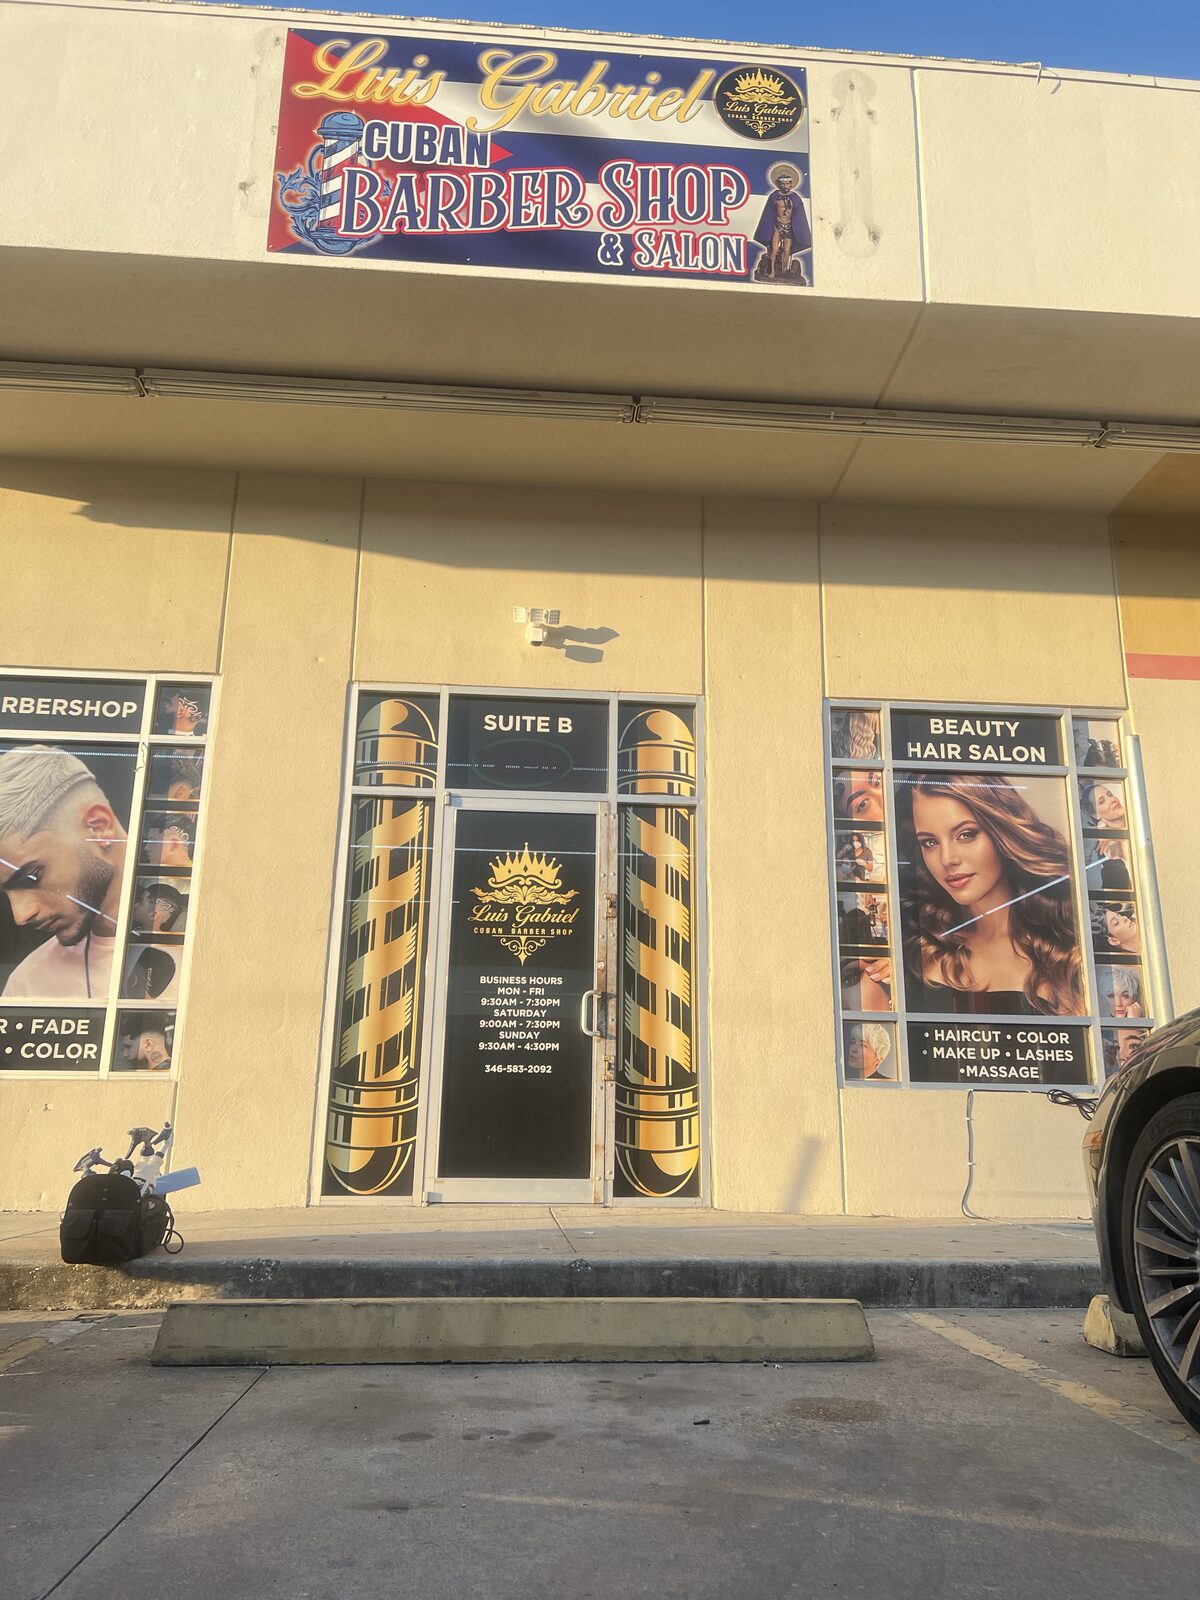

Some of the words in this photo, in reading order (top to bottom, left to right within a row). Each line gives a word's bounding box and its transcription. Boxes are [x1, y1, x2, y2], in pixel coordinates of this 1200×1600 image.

[293, 39, 445, 104] Luis
[465, 50, 714, 133] Gabriel
[723, 101, 750, 112] Luis
[751, 103, 797, 116] Gabriel
[362, 120, 491, 168] CUBAN
[338, 166, 591, 236] BARBER
[599, 160, 749, 229] SHOP
[598, 233, 623, 265] &
[633, 230, 748, 274] SALON
[483, 714, 551, 732] SUITE
[558, 717, 573, 733] B
[929, 718, 1020, 737] BEAUTY
[906, 742, 962, 760] HAIR
[968, 744, 1047, 763] SALON
[467, 904, 508, 922] Luis
[511, 905, 580, 928] Gabriel
[550, 928, 573, 936] SHOP
[480, 976, 527, 985] BUSINESS
[529, 976, 563, 985] HOURS
[497, 987, 520, 995] MON
[529, 987, 545, 996] FRI
[480, 998, 517, 1006] 9:30AM
[526, 998, 560, 1007] 7:30PM
[493, 1009, 547, 1017] SATURDAY
[30, 1018, 91, 1035] FADE
[479, 1019, 517, 1028] 9:00AM
[525, 1020, 560, 1029] 7:30PM
[498, 1031, 540, 1039] SUNDAY
[934, 1029, 1001, 1042] HAIRCUT
[1016, 1031, 1070, 1044] COLOR
[20, 1042, 98, 1059] COLOR
[478, 1042, 515, 1051] 9:30AM
[523, 1042, 560, 1051] 4:30PM
[933, 1046, 977, 1059] MAKE
[980, 1048, 1000, 1060] UP
[1016, 1049, 1074, 1062] LASHES
[484, 1064, 552, 1073] 346-583-2092
